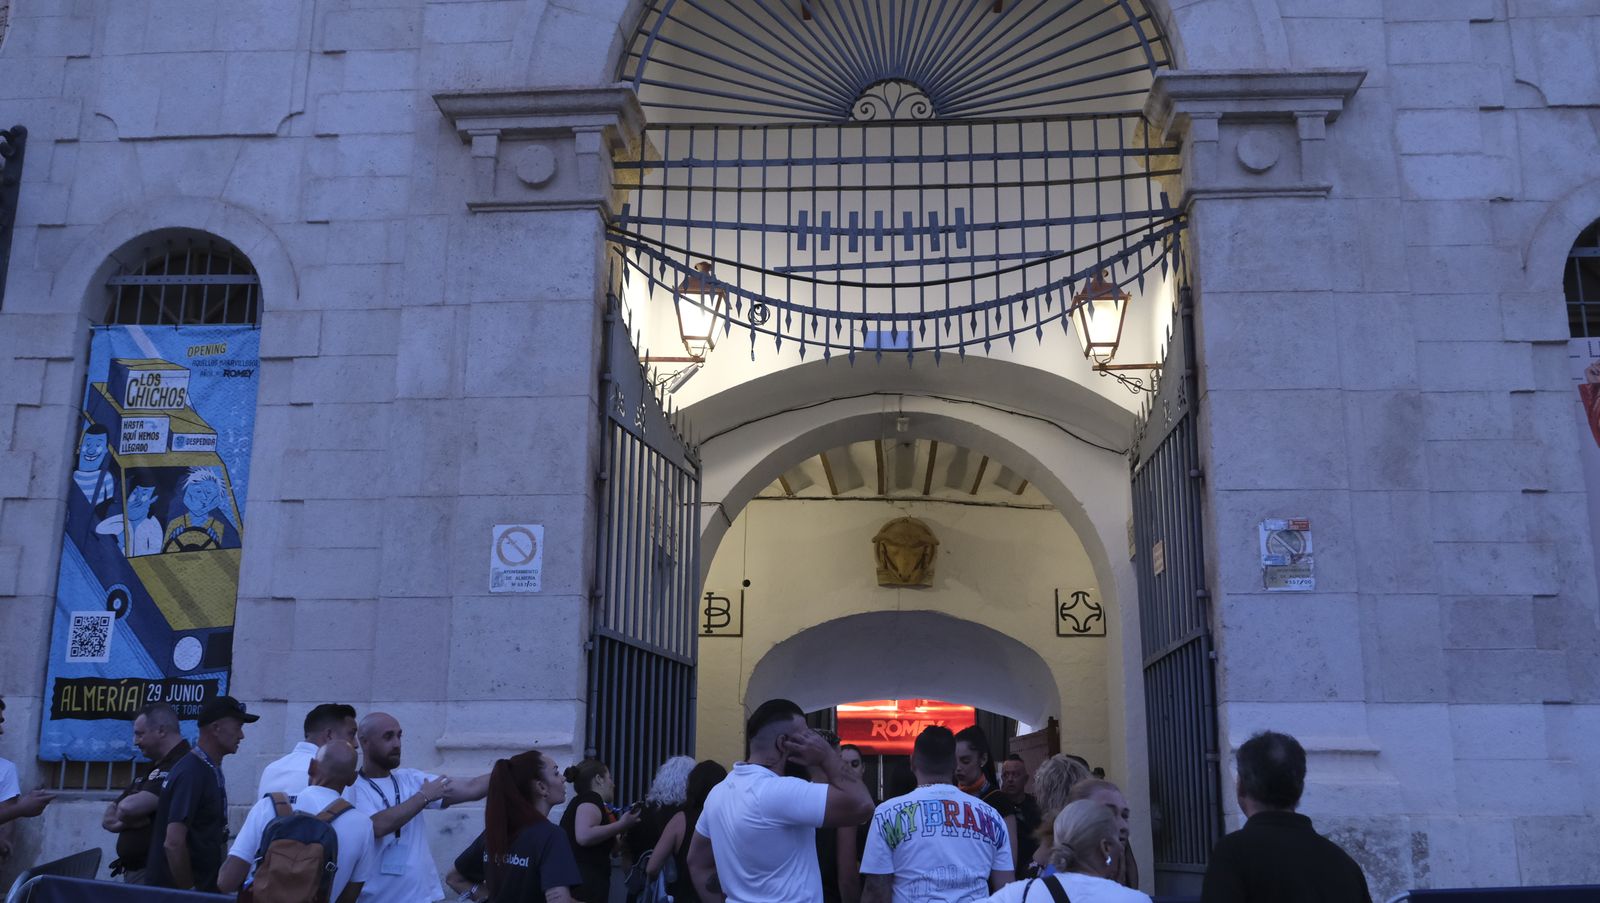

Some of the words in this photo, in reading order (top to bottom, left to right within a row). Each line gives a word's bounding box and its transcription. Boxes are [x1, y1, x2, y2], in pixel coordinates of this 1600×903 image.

[187, 343, 227, 358] OPENING
[140, 373, 161, 387] LOS
[223, 369, 254, 380] ROMEY
[126, 378, 185, 407] CHICHOS
[123, 420, 144, 430] HASTA
[122, 430, 136, 443] AQUÍ
[138, 431, 160, 441] HEMOS
[185, 437, 216, 446] DESPEDIDA
[121, 443, 149, 453] LLEGADO
[60, 678, 139, 712] ALMERÍA
[147, 684, 162, 702] 29
[165, 684, 205, 702] JUNIO
